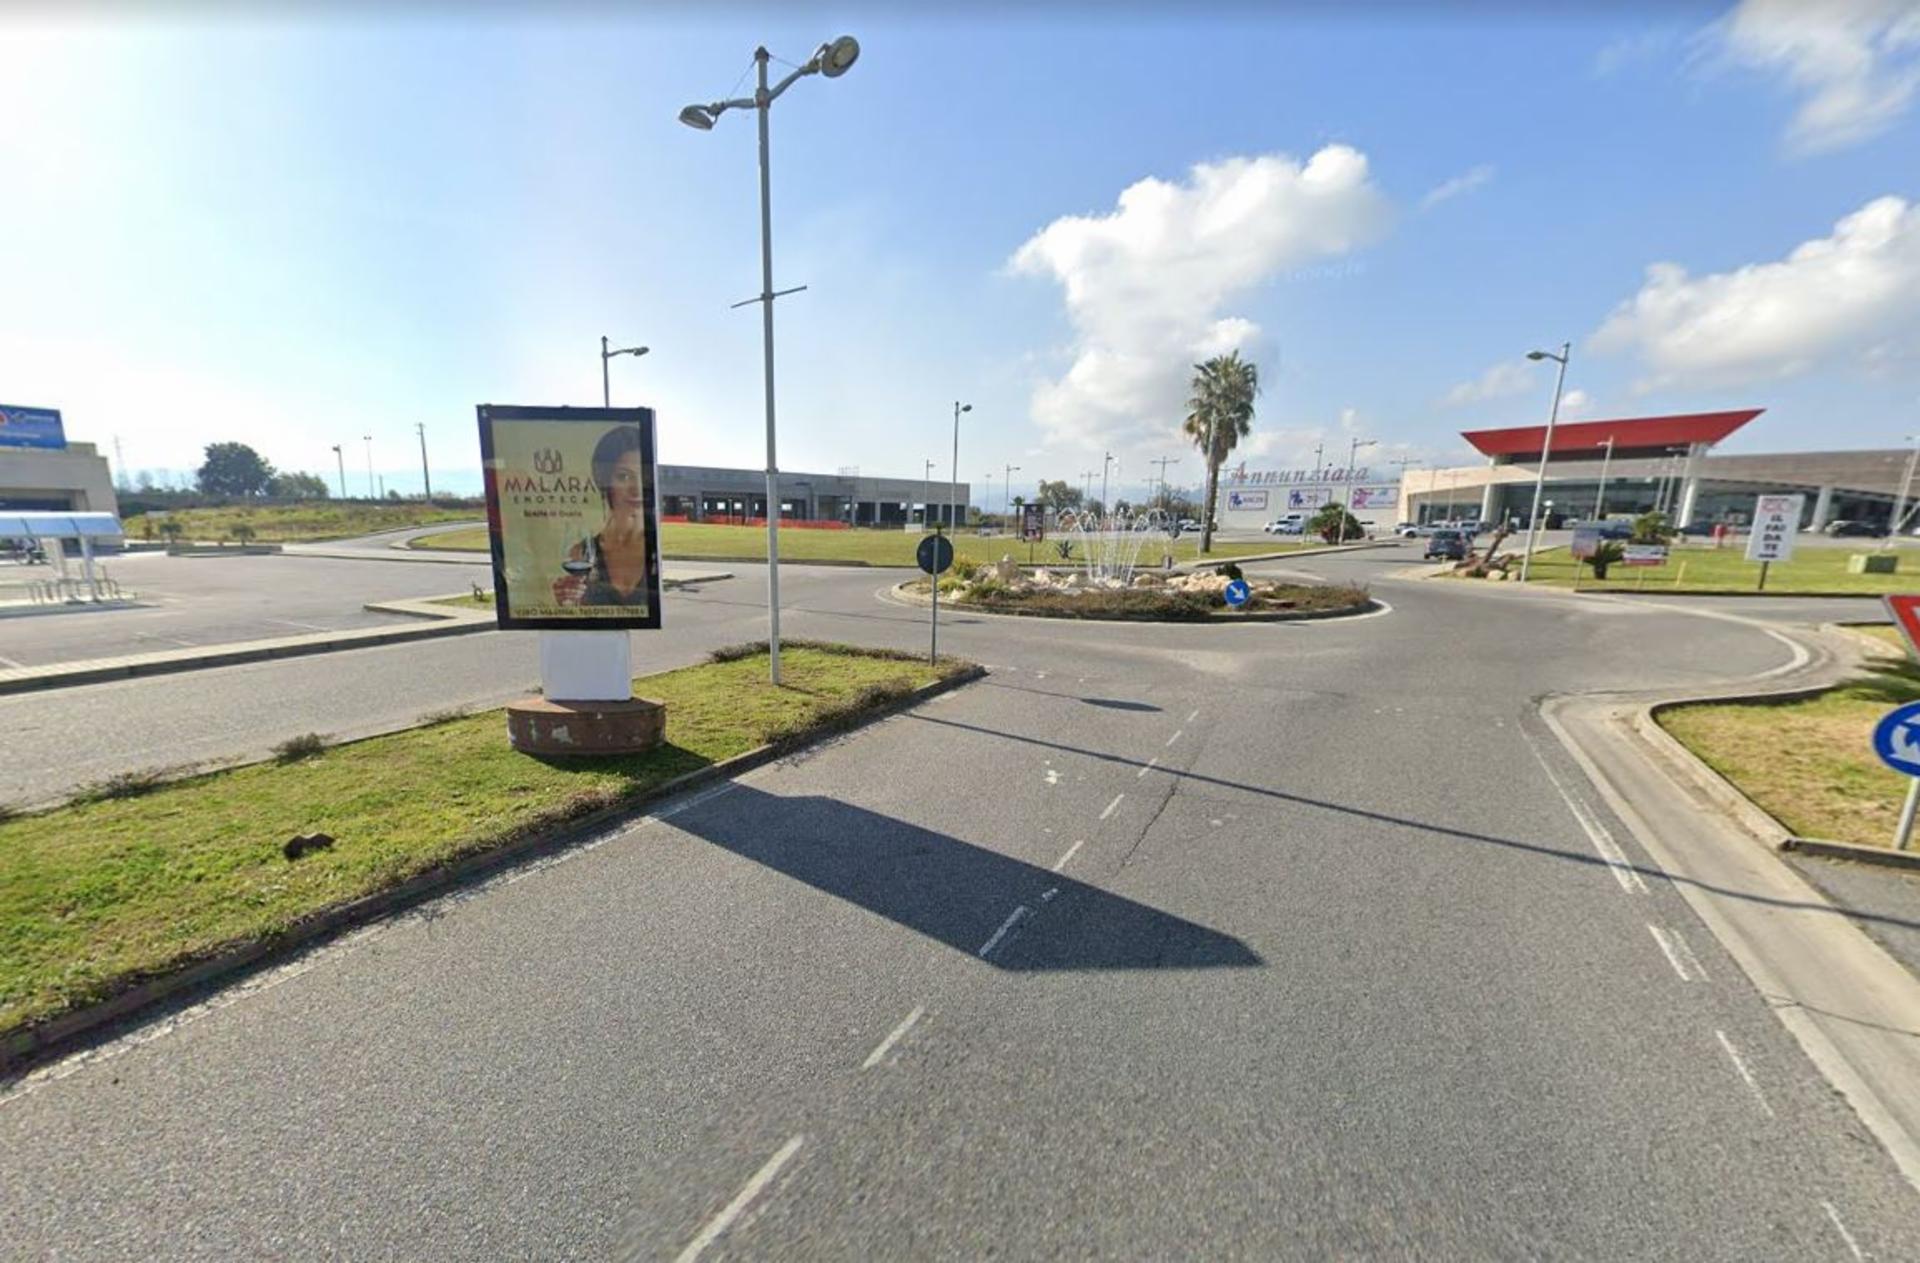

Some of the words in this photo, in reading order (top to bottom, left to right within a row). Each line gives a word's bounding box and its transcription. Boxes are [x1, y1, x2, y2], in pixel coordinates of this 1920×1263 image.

[1231, 461, 1369, 484] Annunziata
[504, 477, 597, 493] MALARA
[513, 496, 589, 504] ENOTECA
